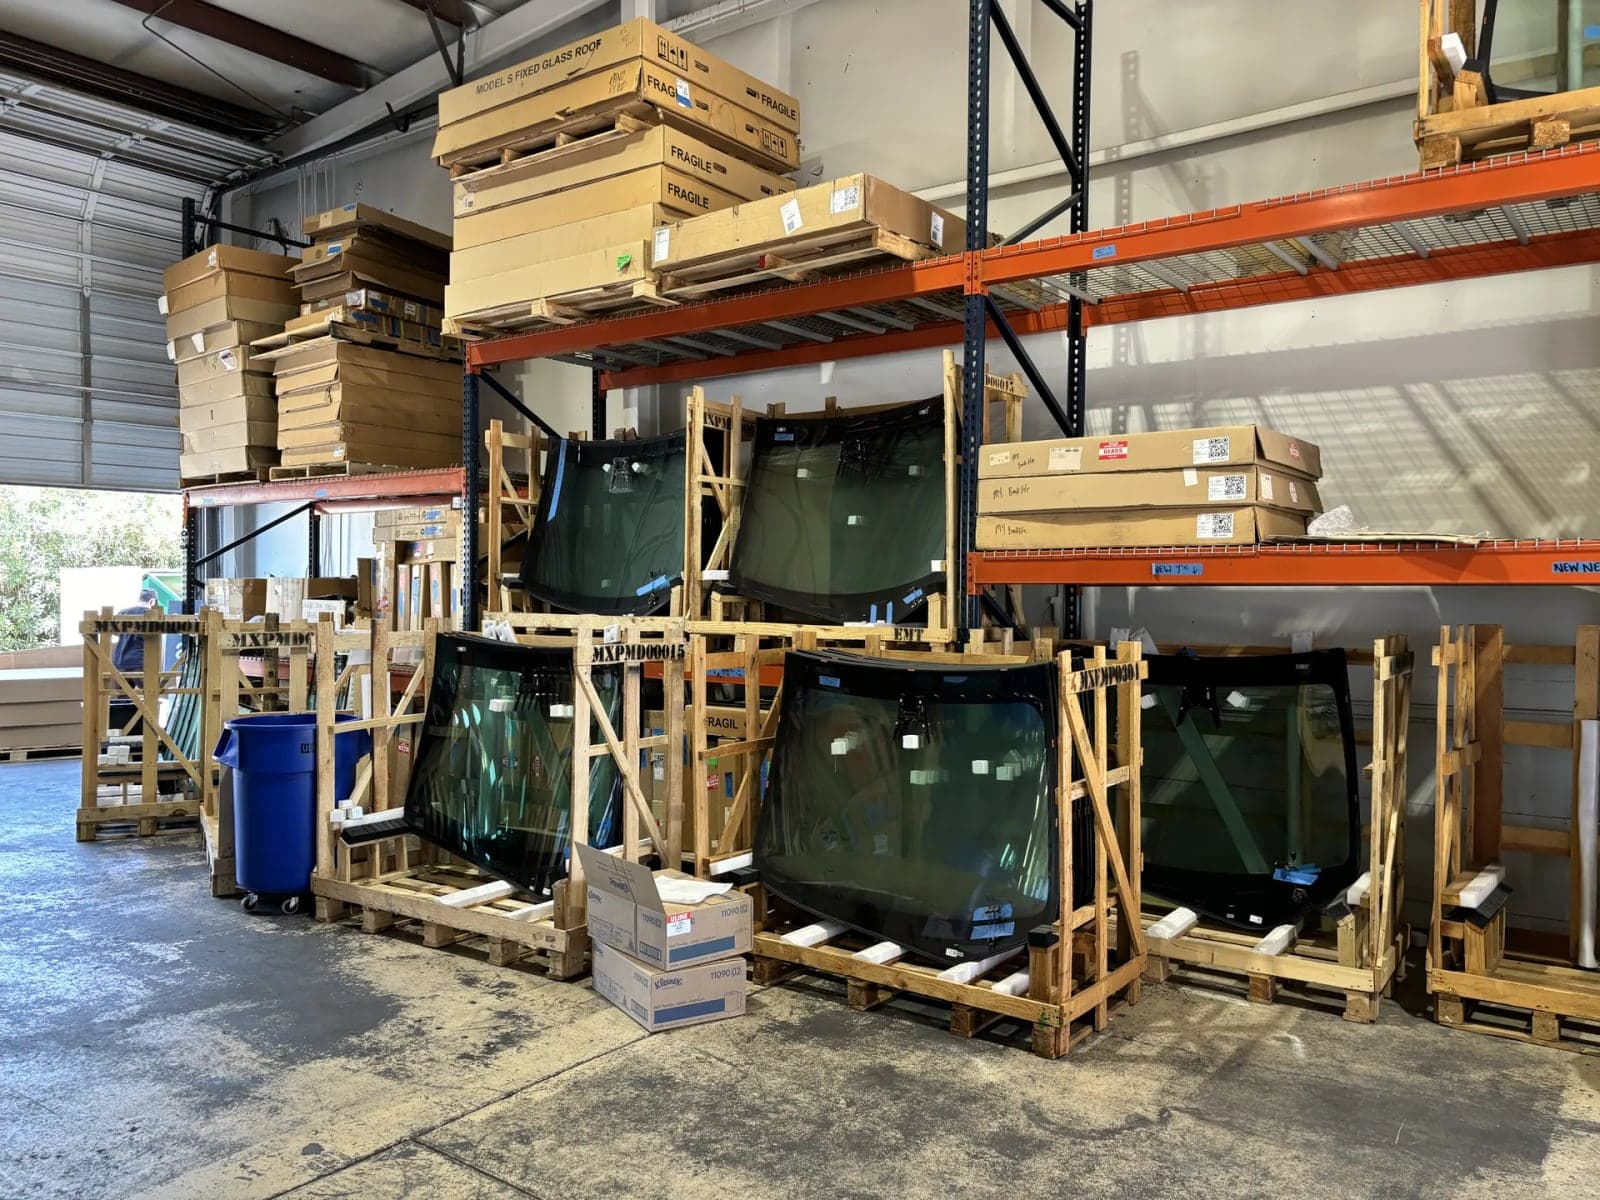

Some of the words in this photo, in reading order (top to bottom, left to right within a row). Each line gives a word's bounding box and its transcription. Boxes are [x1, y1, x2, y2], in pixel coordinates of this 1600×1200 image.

[476, 78, 505, 95] MODEL
[507, 73, 513, 84] S
[515, 64, 540, 82] FIXED
[542, 51, 573, 69] GLASS
[575, 39, 602, 57] ROOF
[647, 75, 677, 98] FRAG
[761, 94, 796, 121] FRAGILE
[671, 145, 713, 174] FRAGILE
[668, 183, 709, 210] FRAGILE
[1554, 562, 1579, 573] NEW
[1582, 562, 1600, 573] NE
[592, 643, 685, 662] MXPMD00015
